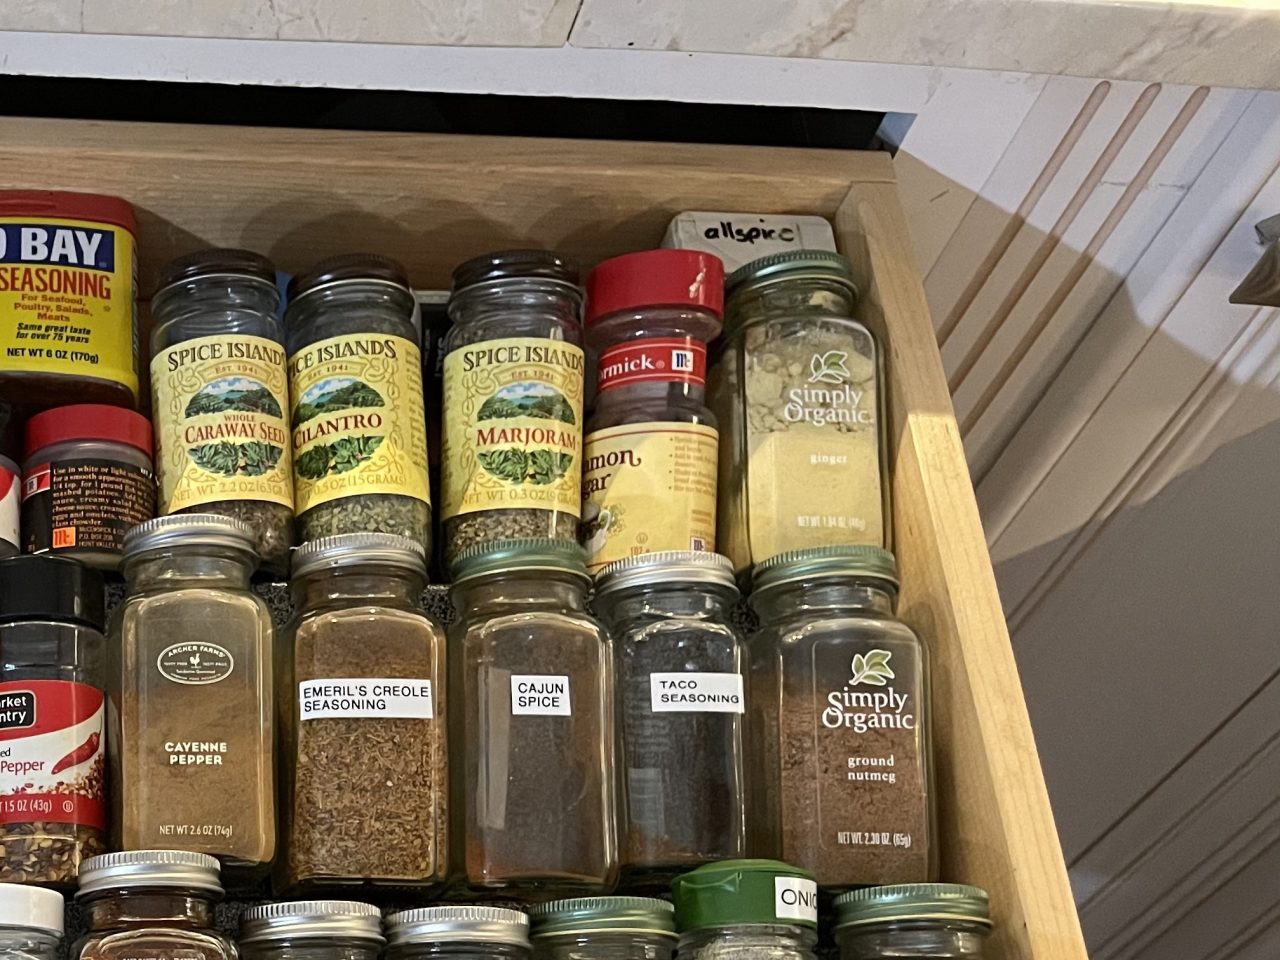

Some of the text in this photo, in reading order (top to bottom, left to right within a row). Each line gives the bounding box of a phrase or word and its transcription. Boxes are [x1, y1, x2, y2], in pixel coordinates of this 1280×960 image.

[704, 220, 795, 242] allspice
[20, 227, 103, 266] BAY
[168, 343, 222, 372] SPICE
[318, 340, 396, 361] ISLANDS
[464, 346, 583, 376] SPICE ISLANDS
[789, 384, 863, 409] Simply
[185, 421, 285, 444] CARAWAY SEED
[294, 413, 382, 449] CILANTRO
[476, 427, 576, 450] MARJORAM
[303, 685, 429, 699] EMERIL'S CREOLE
[518, 682, 564, 694] CAJUN
[659, 680, 698, 690] TACO
[304, 700, 386, 712] SEASONING
[518, 696, 560, 708] SPICE
[660, 693, 740, 704] SEASONING
[827, 686, 908, 713] Simply
[822, 706, 914, 734] Organic
[165, 742, 227, 752] CAYENNE
[1, 760, 45, 775] Pepper
[170, 755, 222, 765] PEPPER
[848, 754, 895, 768] ground
[848, 770, 896, 784] nutmeg
